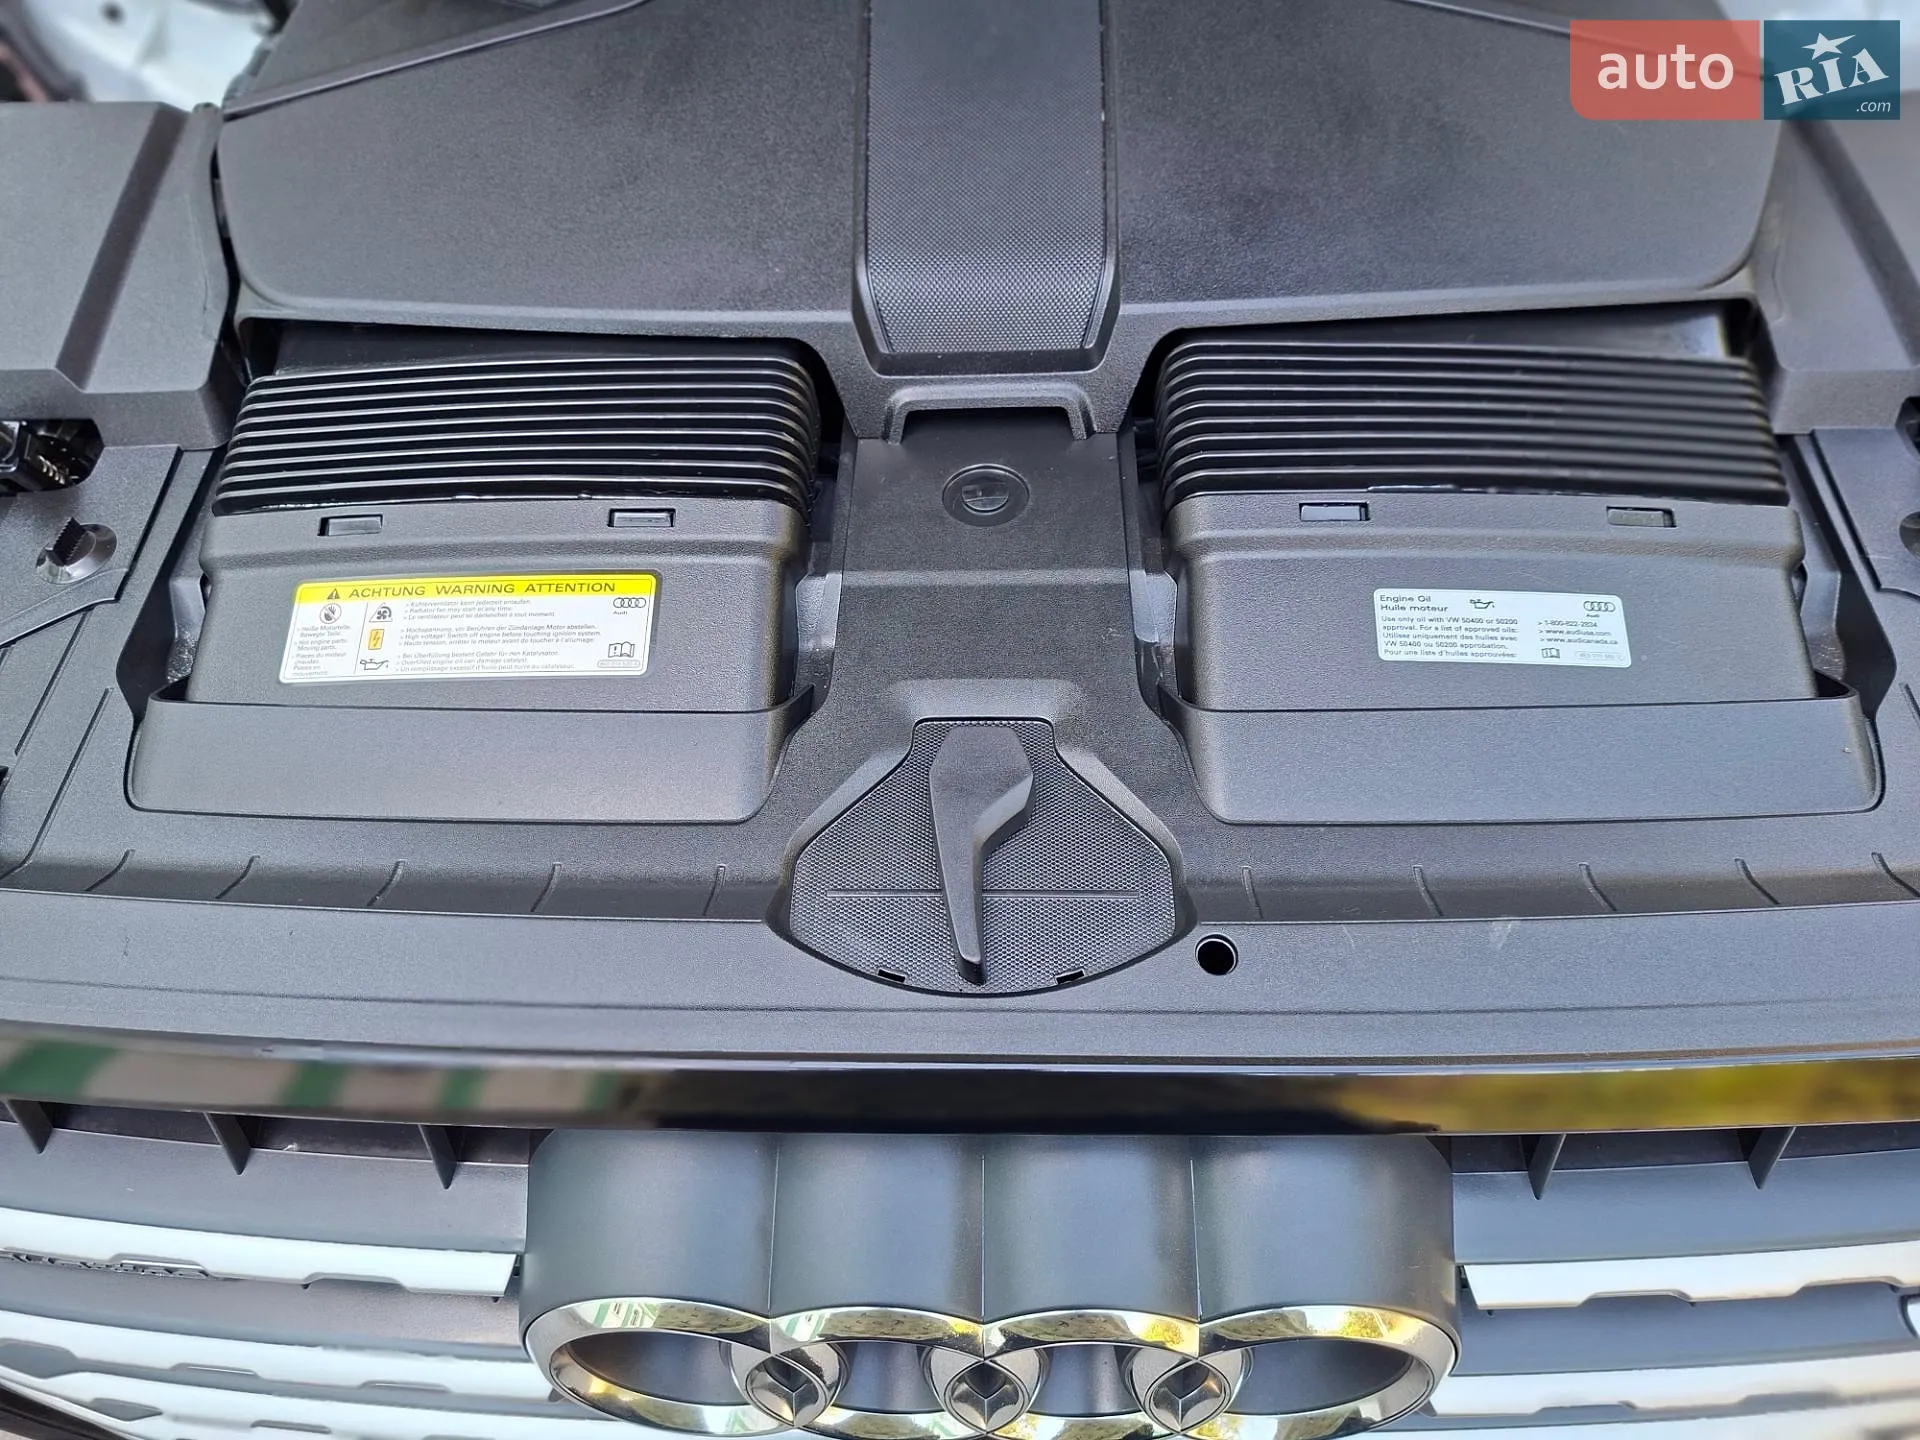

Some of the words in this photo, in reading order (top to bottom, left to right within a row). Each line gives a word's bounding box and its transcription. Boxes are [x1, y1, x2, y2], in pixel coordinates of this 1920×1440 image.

[349, 585, 426, 598] ACHTUNG
[435, 583, 515, 595] WARNING
[525, 582, 615, 593] ATTENTION
[1380, 595, 1414, 603] Engine
[1464, 626, 1501, 634] approved
[1412, 633, 1458, 641] uniquement
